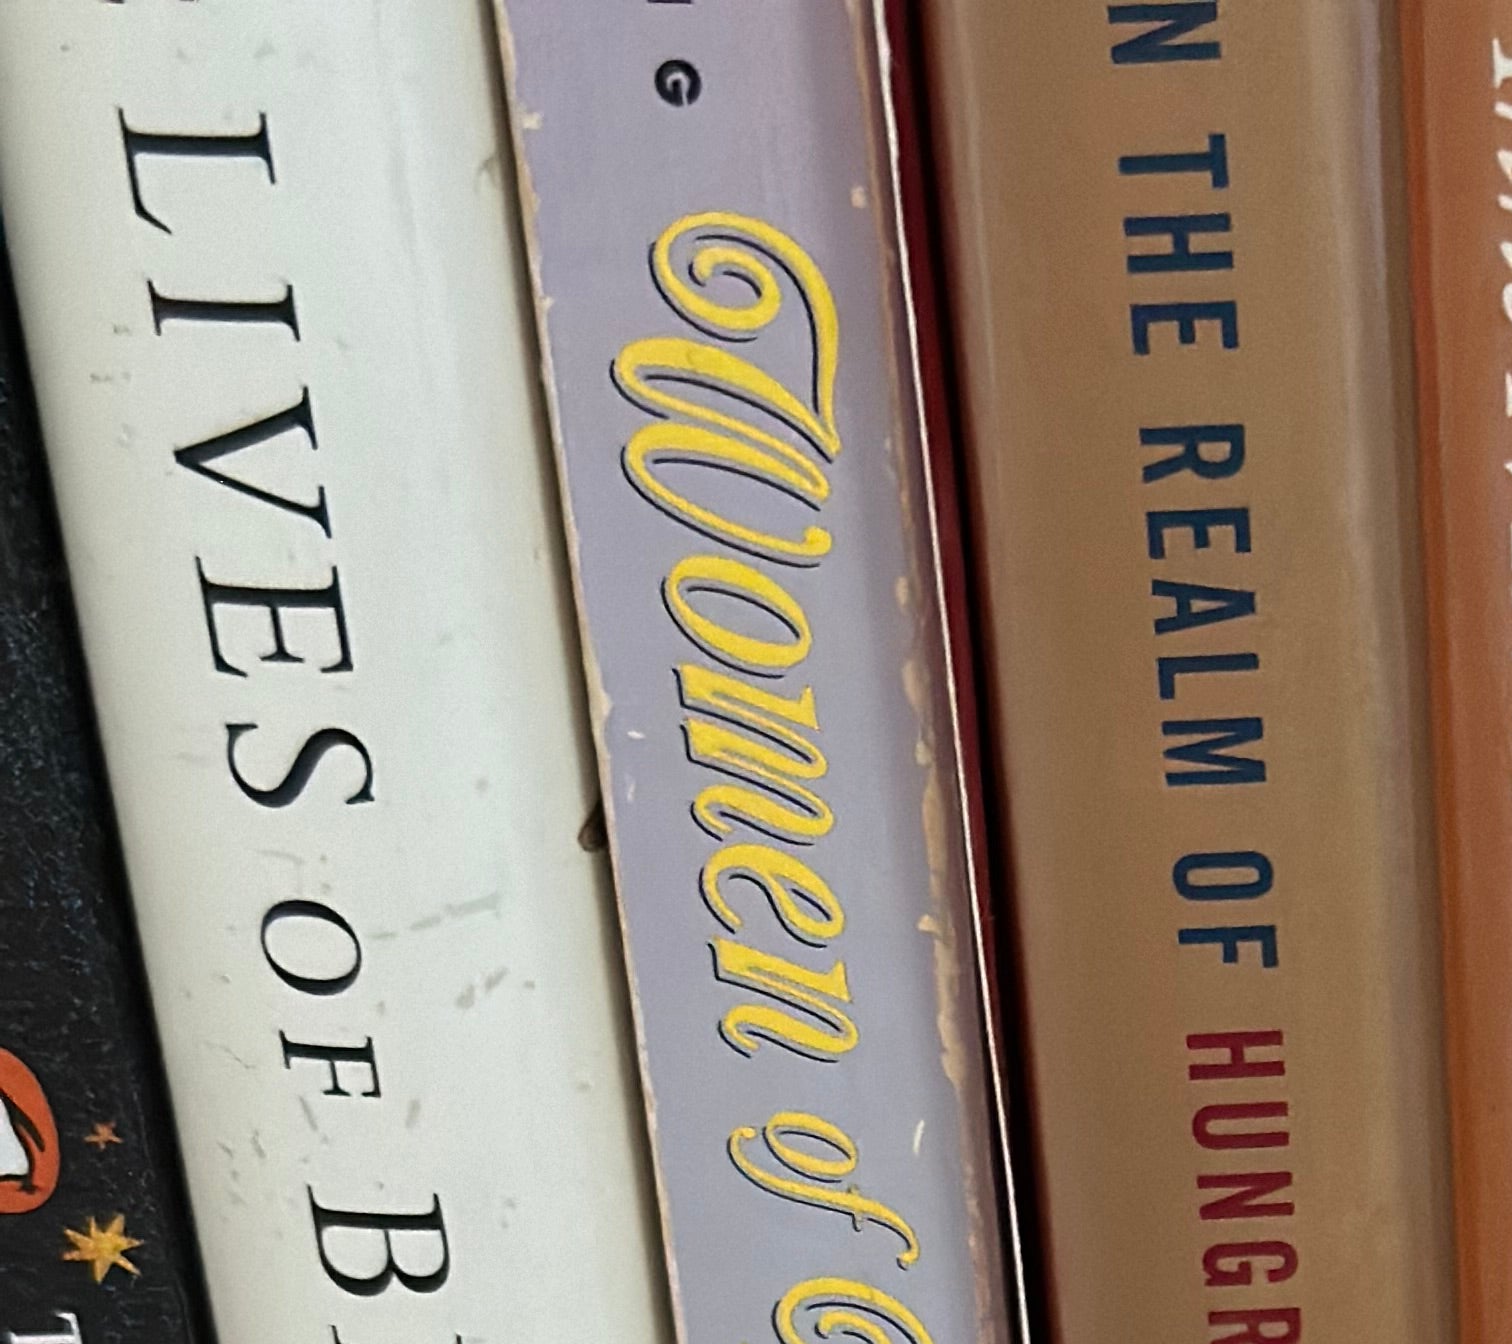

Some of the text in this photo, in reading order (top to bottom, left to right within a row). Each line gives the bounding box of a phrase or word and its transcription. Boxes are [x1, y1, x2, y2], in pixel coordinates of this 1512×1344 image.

[1118, 132, 1239, 355] THE
[116, 106, 374, 808] LIVES
[260, 899, 382, 1100] OF
[610, 211, 860, 1062] Women
[1139, 423, 1267, 788] REALM
[1171, 849, 1279, 969] OF
[728, 1111, 920, 1270] of
